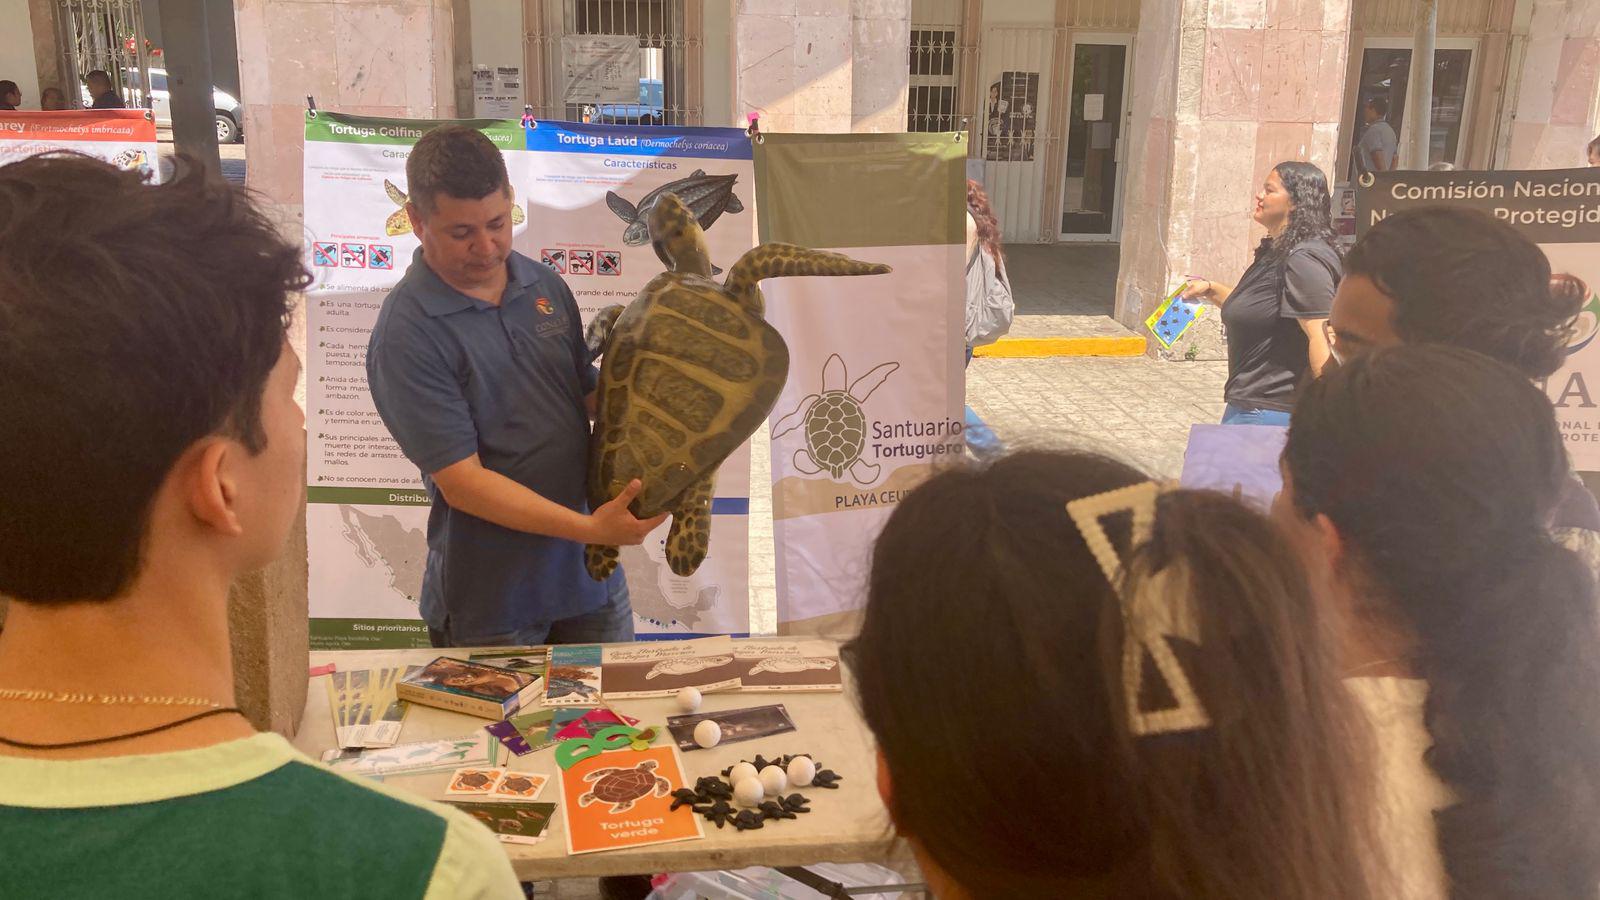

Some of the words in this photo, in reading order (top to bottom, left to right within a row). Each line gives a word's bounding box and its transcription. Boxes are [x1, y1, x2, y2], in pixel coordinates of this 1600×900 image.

[329, 123, 376, 137] Tortuga
[379, 126, 423, 138] Golfina
[557, 133, 604, 147] Tortuga
[608, 134, 637, 146] Laúd
[640, 138, 692, 152] (Dermochelys
[603, 158, 677, 170] Características
[1391, 180, 1505, 200] Comisión
[575, 289, 601, 297] grande
[325, 408, 334, 416] Es
[872, 417, 963, 440] Santuario
[872, 442, 963, 459] Tortuguero
[835, 493, 878, 508] PLAYA
[352, 623, 375, 631] Sitios
[377, 624, 421, 633] prioritarios
[599, 816, 665, 831] Tortuga
[609, 827, 660, 840] verde
